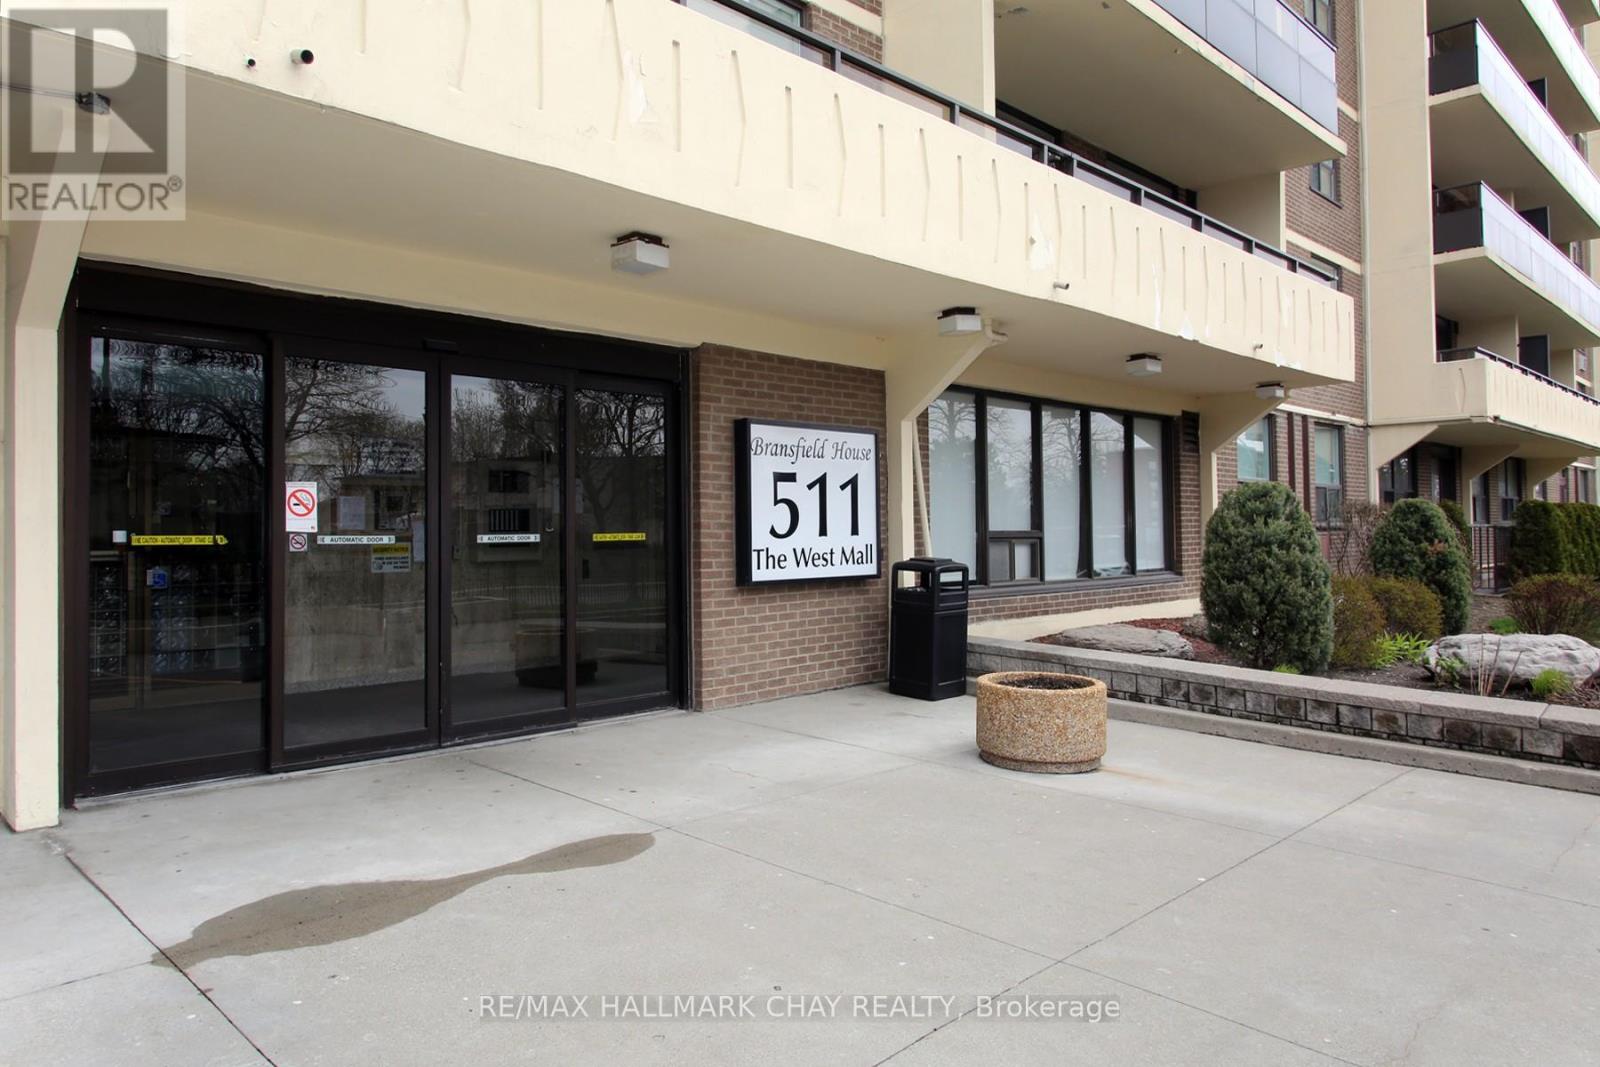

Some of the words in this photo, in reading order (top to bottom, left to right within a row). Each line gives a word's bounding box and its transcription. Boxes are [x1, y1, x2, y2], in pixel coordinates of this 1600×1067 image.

[751, 436, 828, 465] Bransfield
[831, 441, 872, 461] House
[769, 471, 859, 539] 511
[753, 547, 787, 570] The
[793, 546, 835, 568] West
[840, 543, 873, 565] Mall
